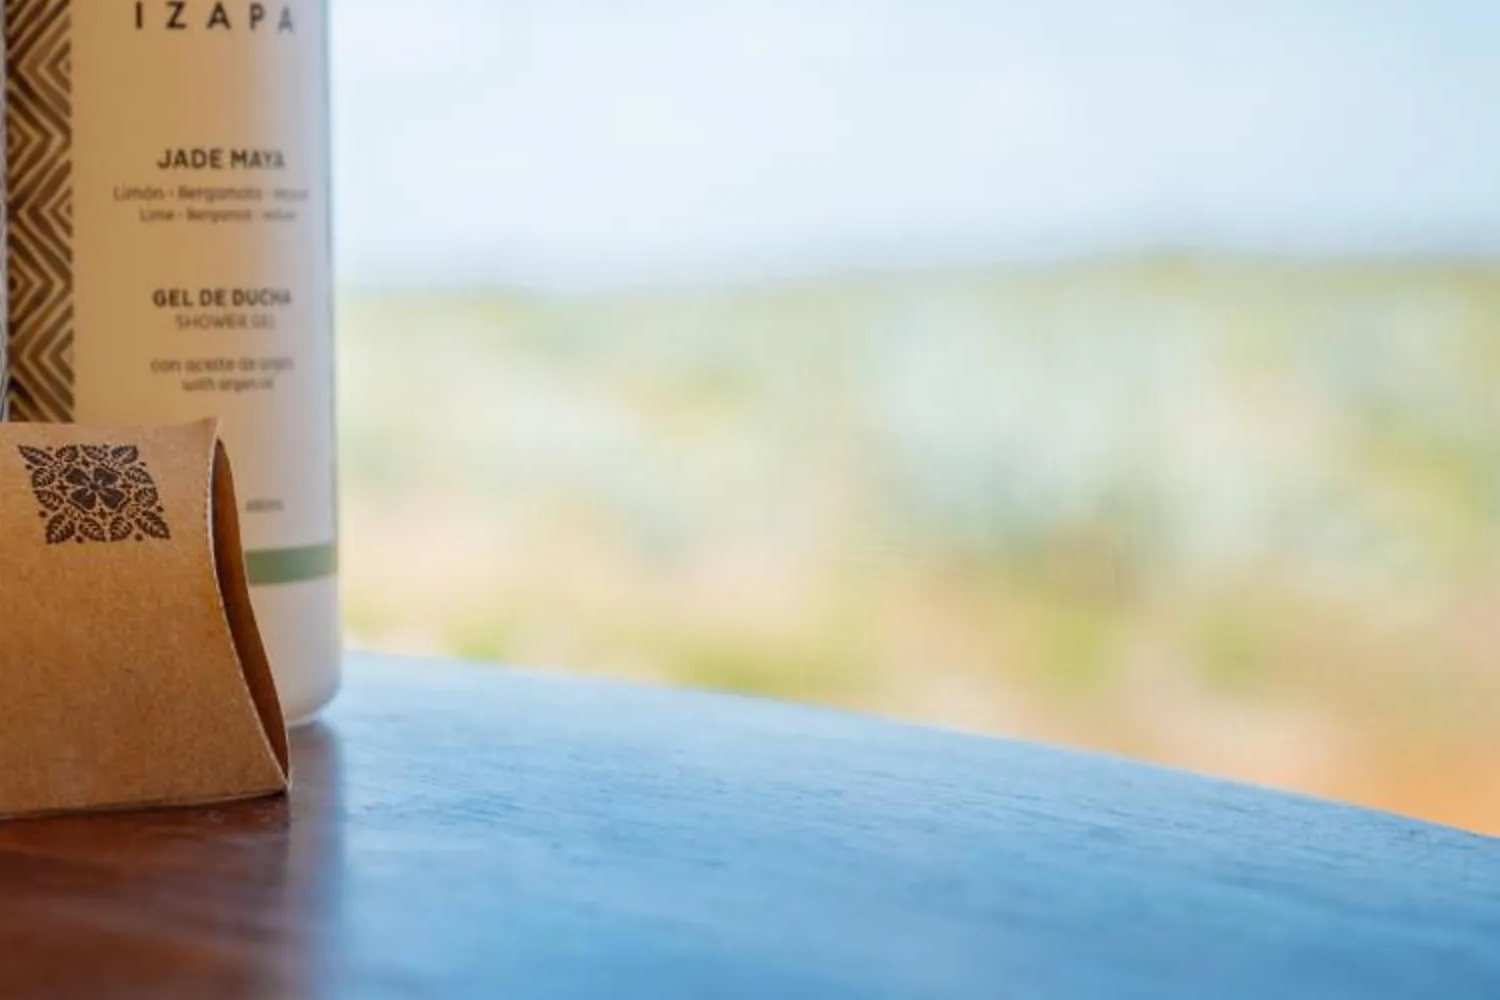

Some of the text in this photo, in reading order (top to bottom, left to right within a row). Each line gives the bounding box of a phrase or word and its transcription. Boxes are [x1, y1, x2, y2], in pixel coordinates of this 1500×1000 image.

[134, 0, 294, 33] IZAPA
[156, 148, 285, 170] JADE MAYA
[152, 288, 292, 308] GEL DE DUCHA
[174, 313, 247, 331] SHOWER
